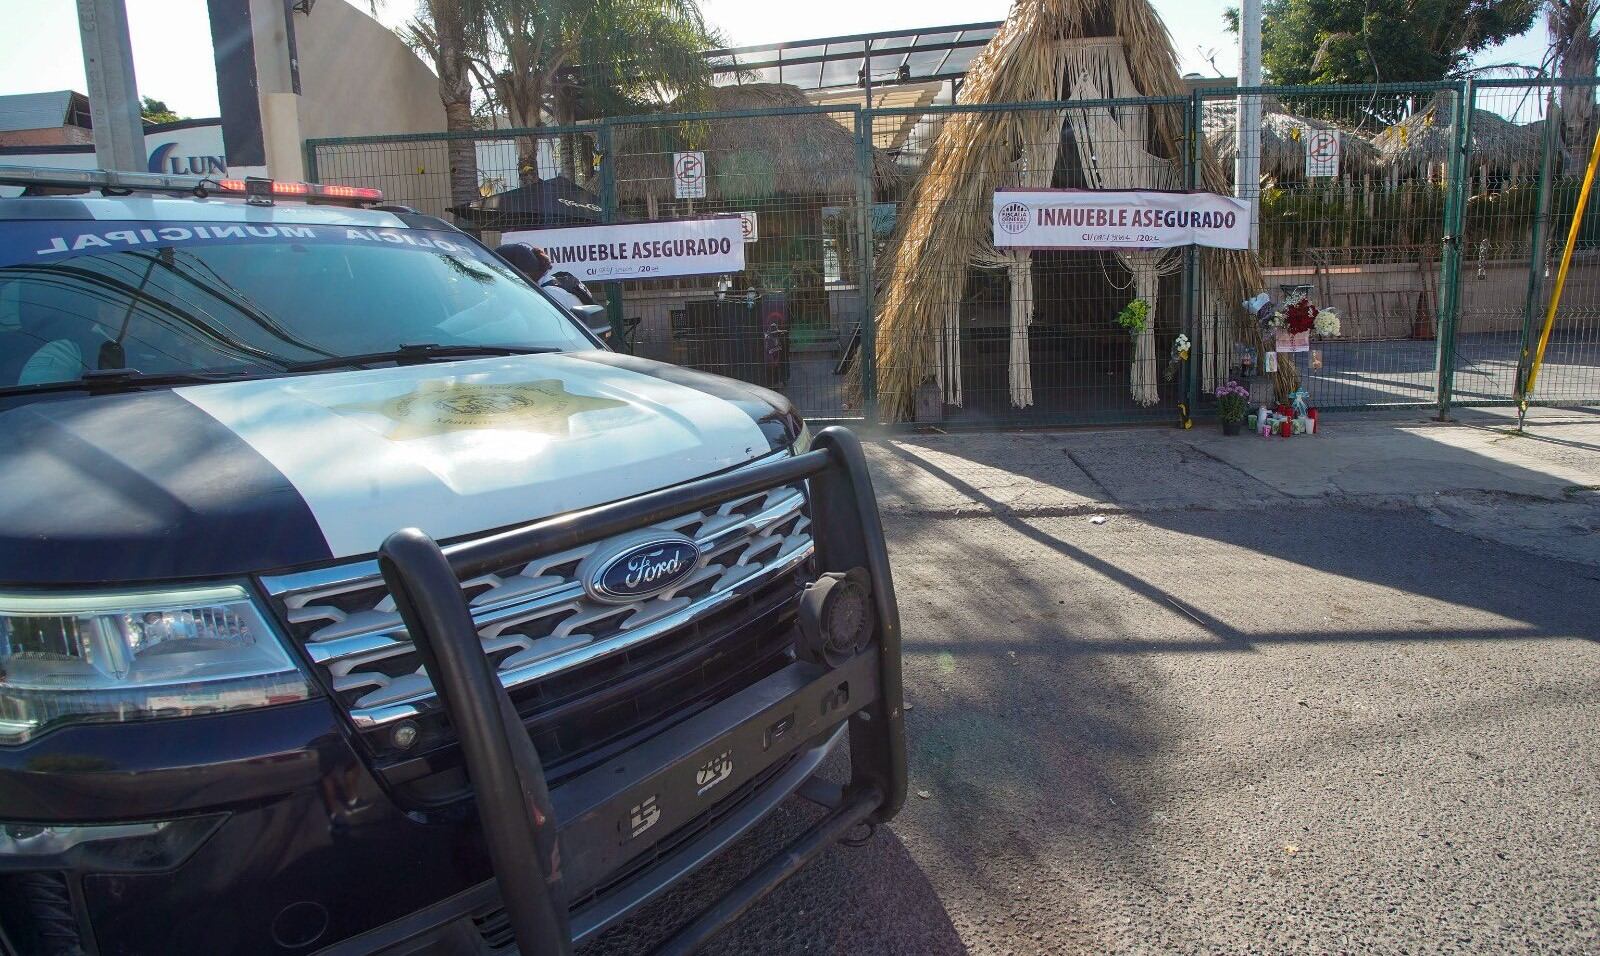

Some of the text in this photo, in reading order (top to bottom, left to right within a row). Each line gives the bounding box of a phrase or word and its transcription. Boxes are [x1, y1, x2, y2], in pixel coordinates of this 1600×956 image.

[1037, 208, 1236, 229] INMUEBLE ASEGURADO
[544, 237, 731, 264] INMUEBLE ASEGURADO
[625, 549, 684, 589] Ford
